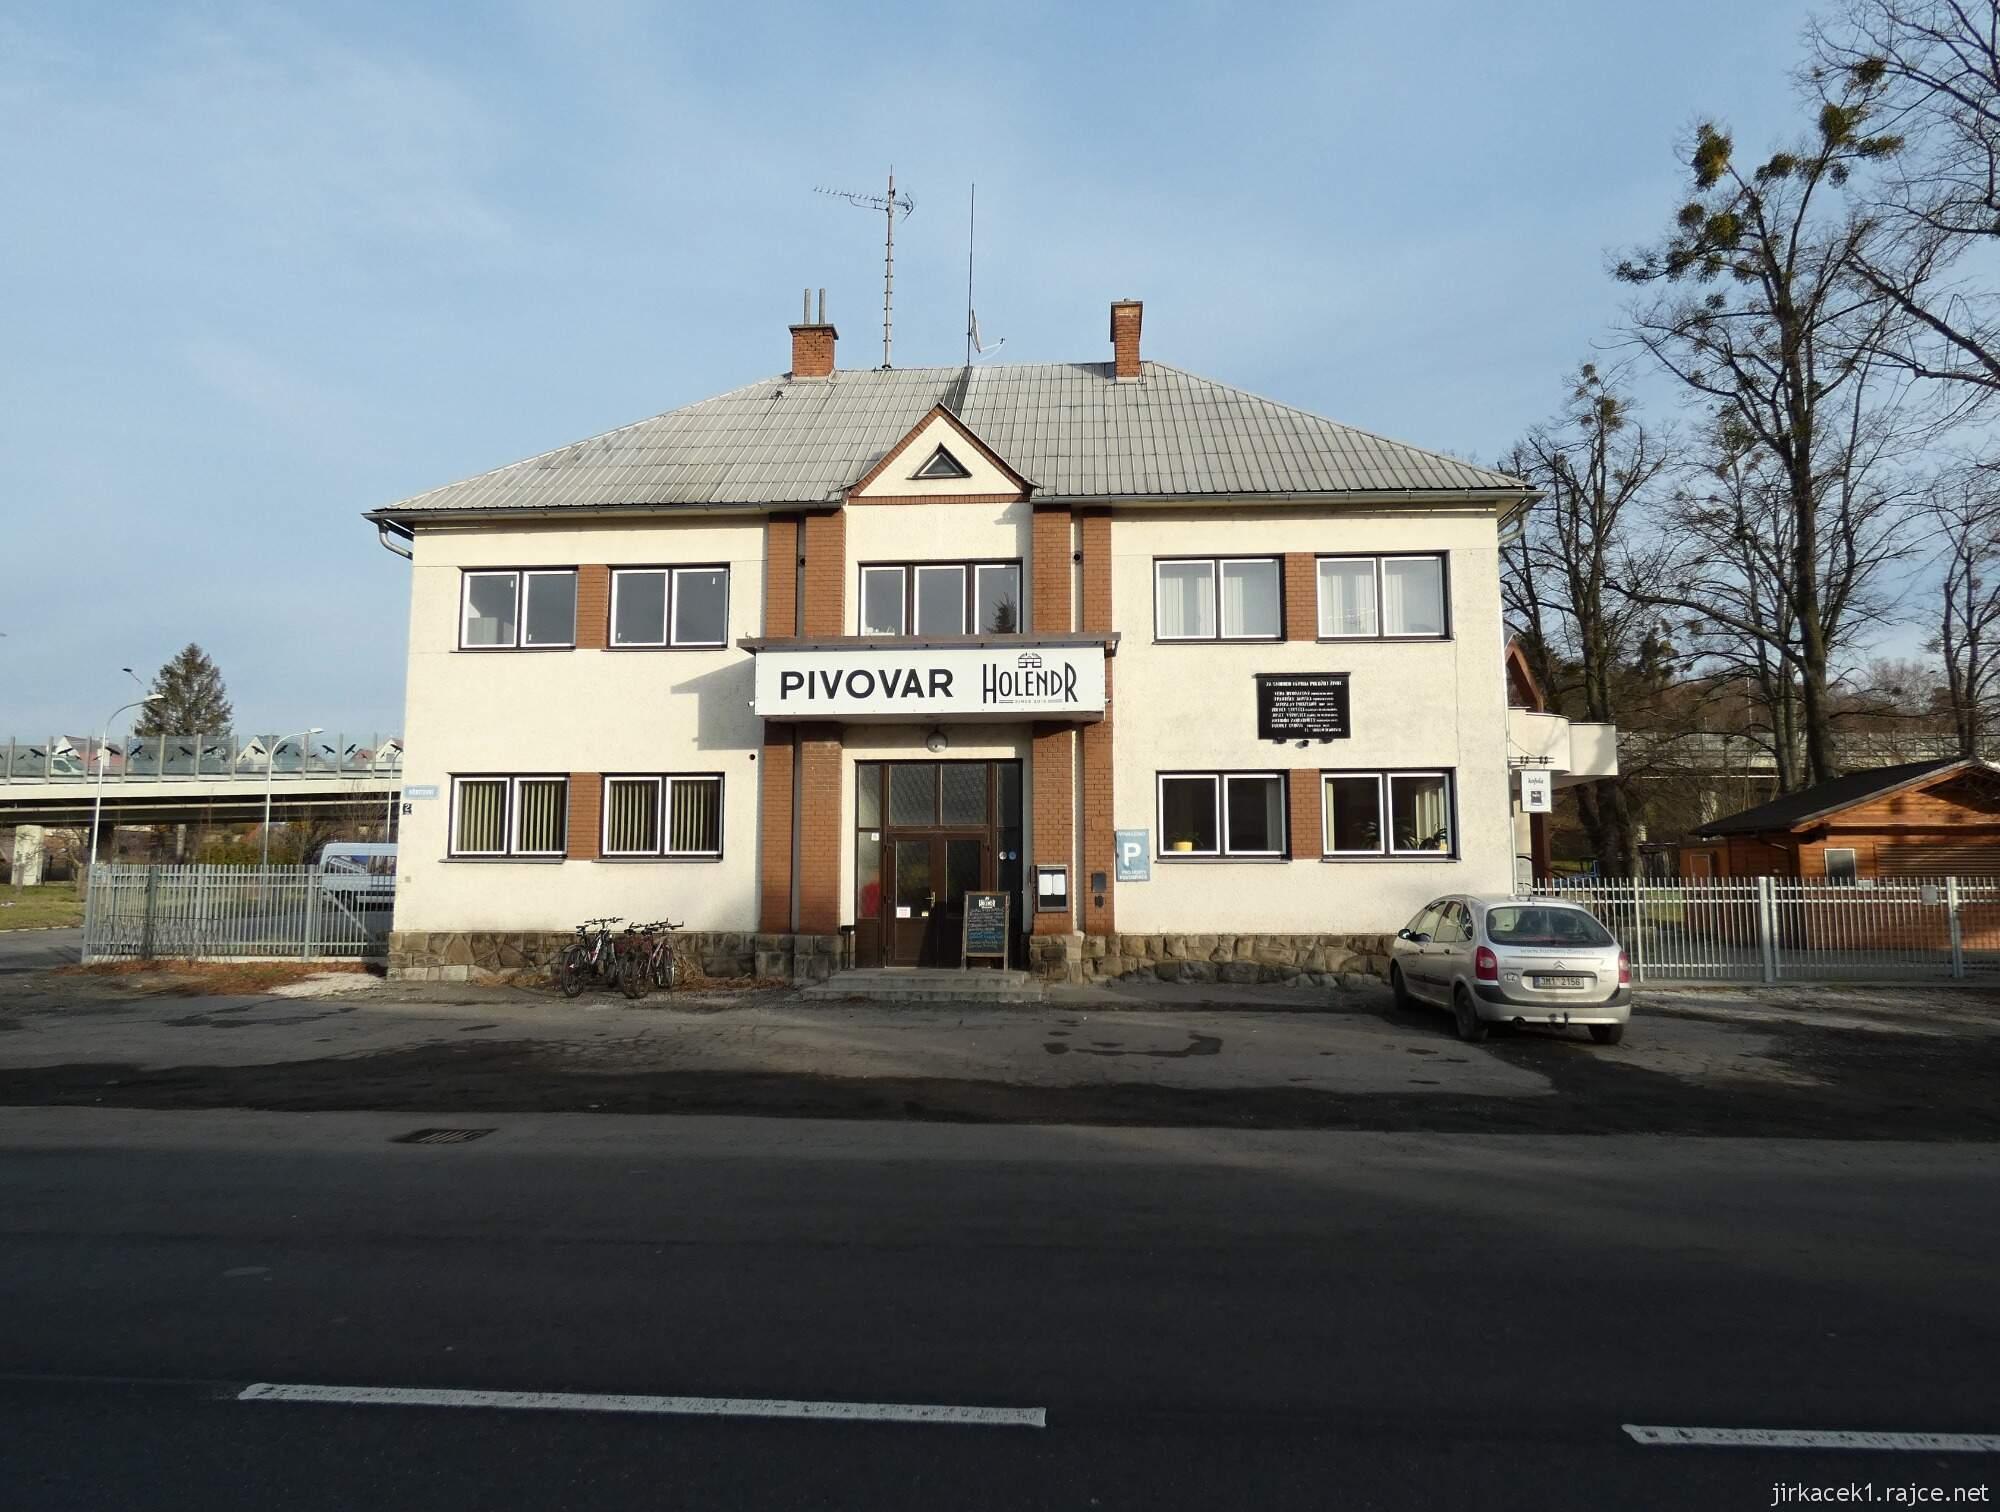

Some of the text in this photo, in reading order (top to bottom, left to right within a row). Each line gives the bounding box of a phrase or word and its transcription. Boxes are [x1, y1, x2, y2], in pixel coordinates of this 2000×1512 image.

[780, 661, 1079, 704] PIVOVAR HOLENDR
[1124, 843, 1141, 866] P
